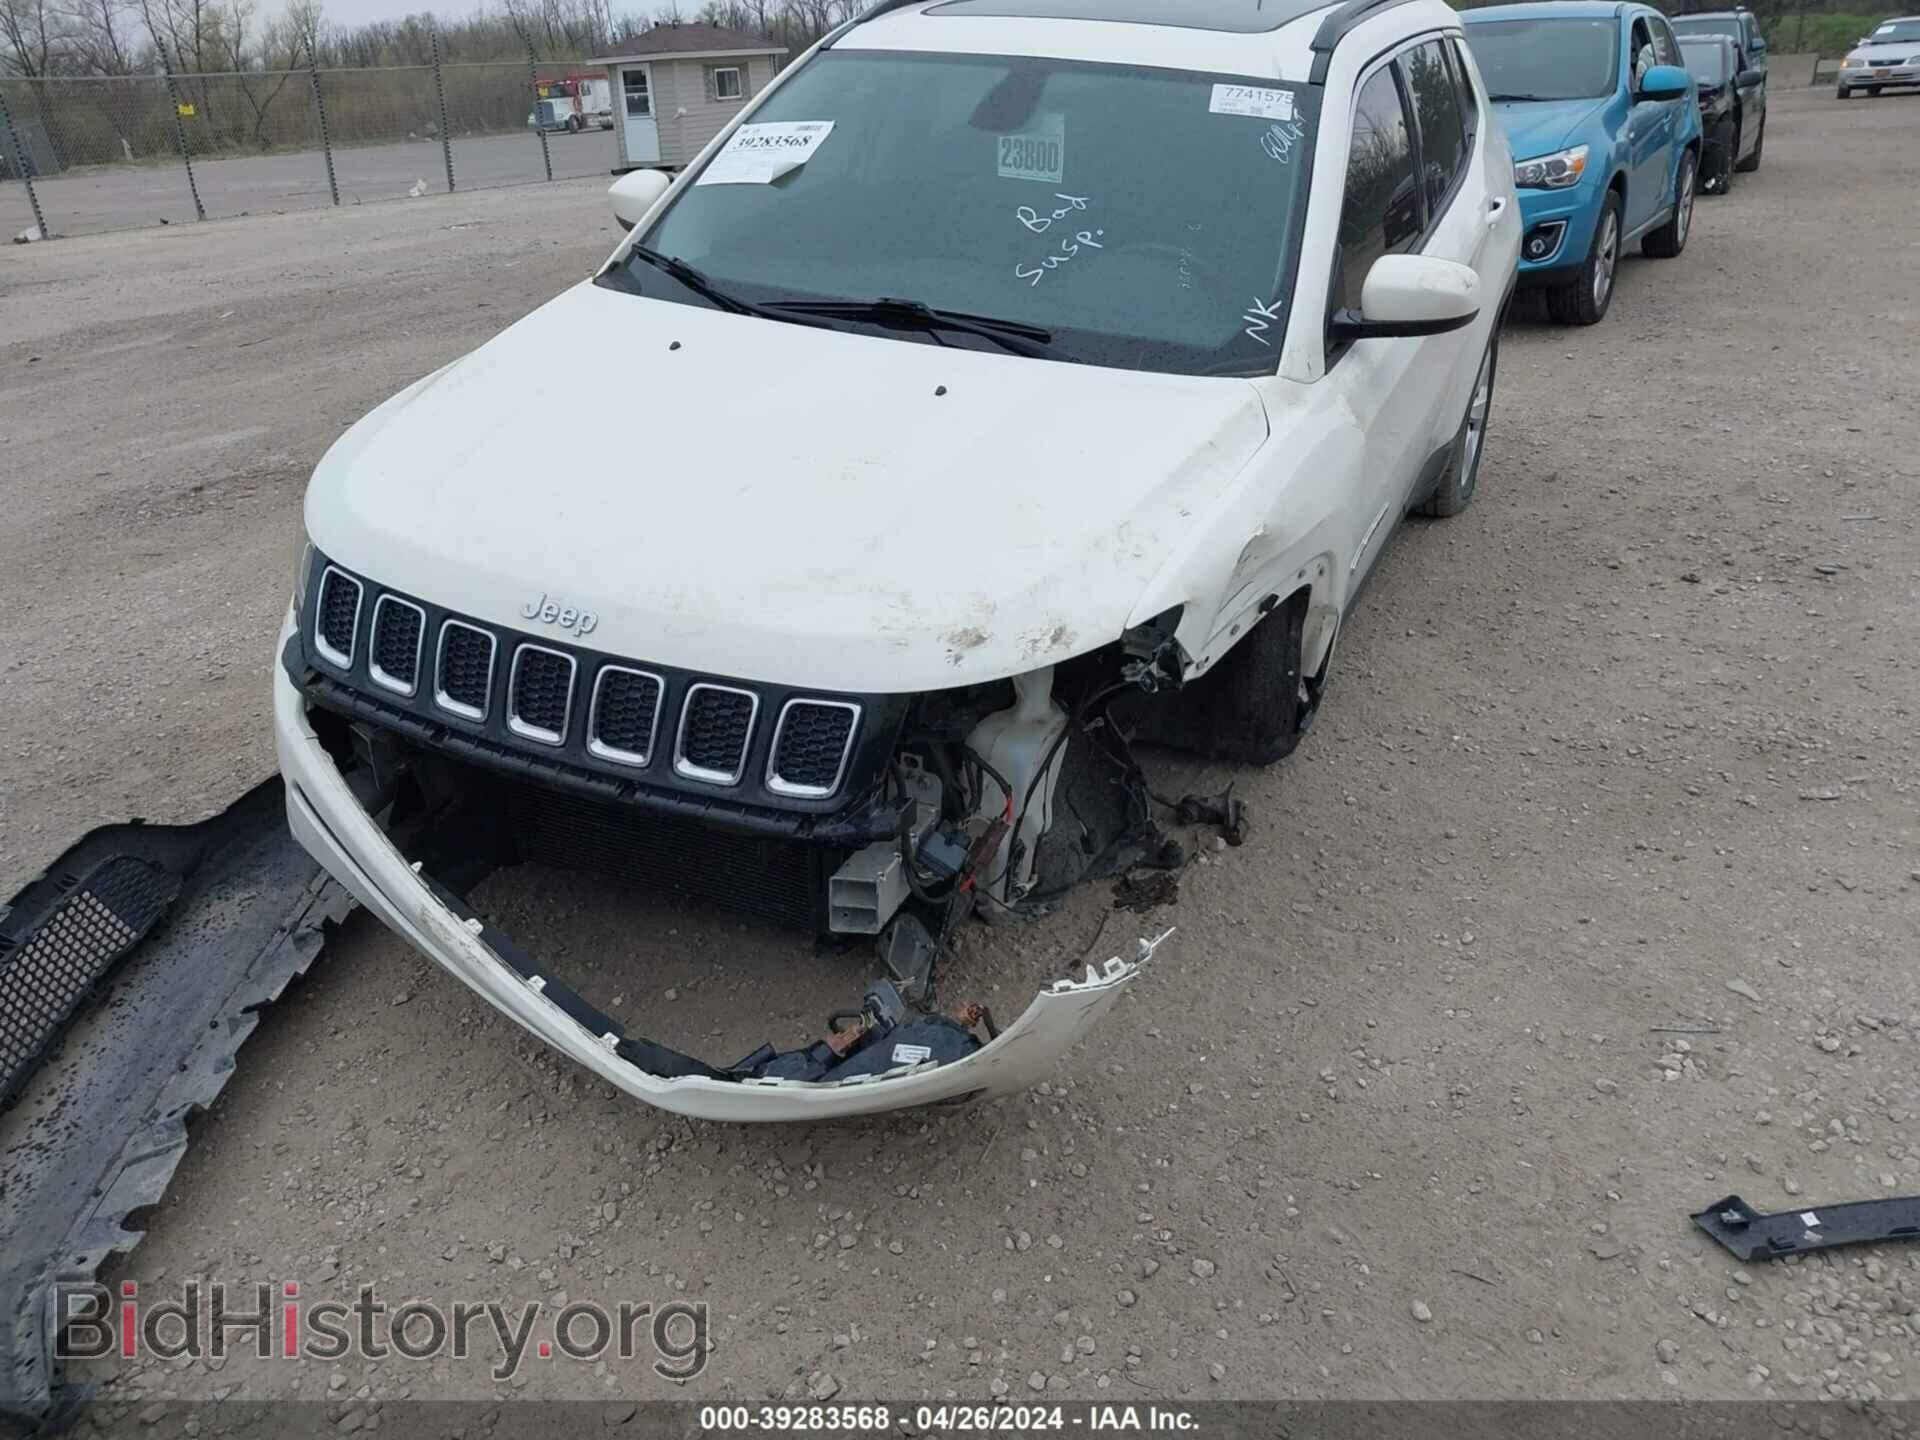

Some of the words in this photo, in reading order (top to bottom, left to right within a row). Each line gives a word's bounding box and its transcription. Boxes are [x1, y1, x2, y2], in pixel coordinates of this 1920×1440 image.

[1225, 87, 1294, 105] 7741575
[1016, 192, 1091, 233] Bad
[1015, 229, 1104, 287] Susp.
[1243, 296, 1283, 347] NK
[520, 591, 599, 638] Jeep
